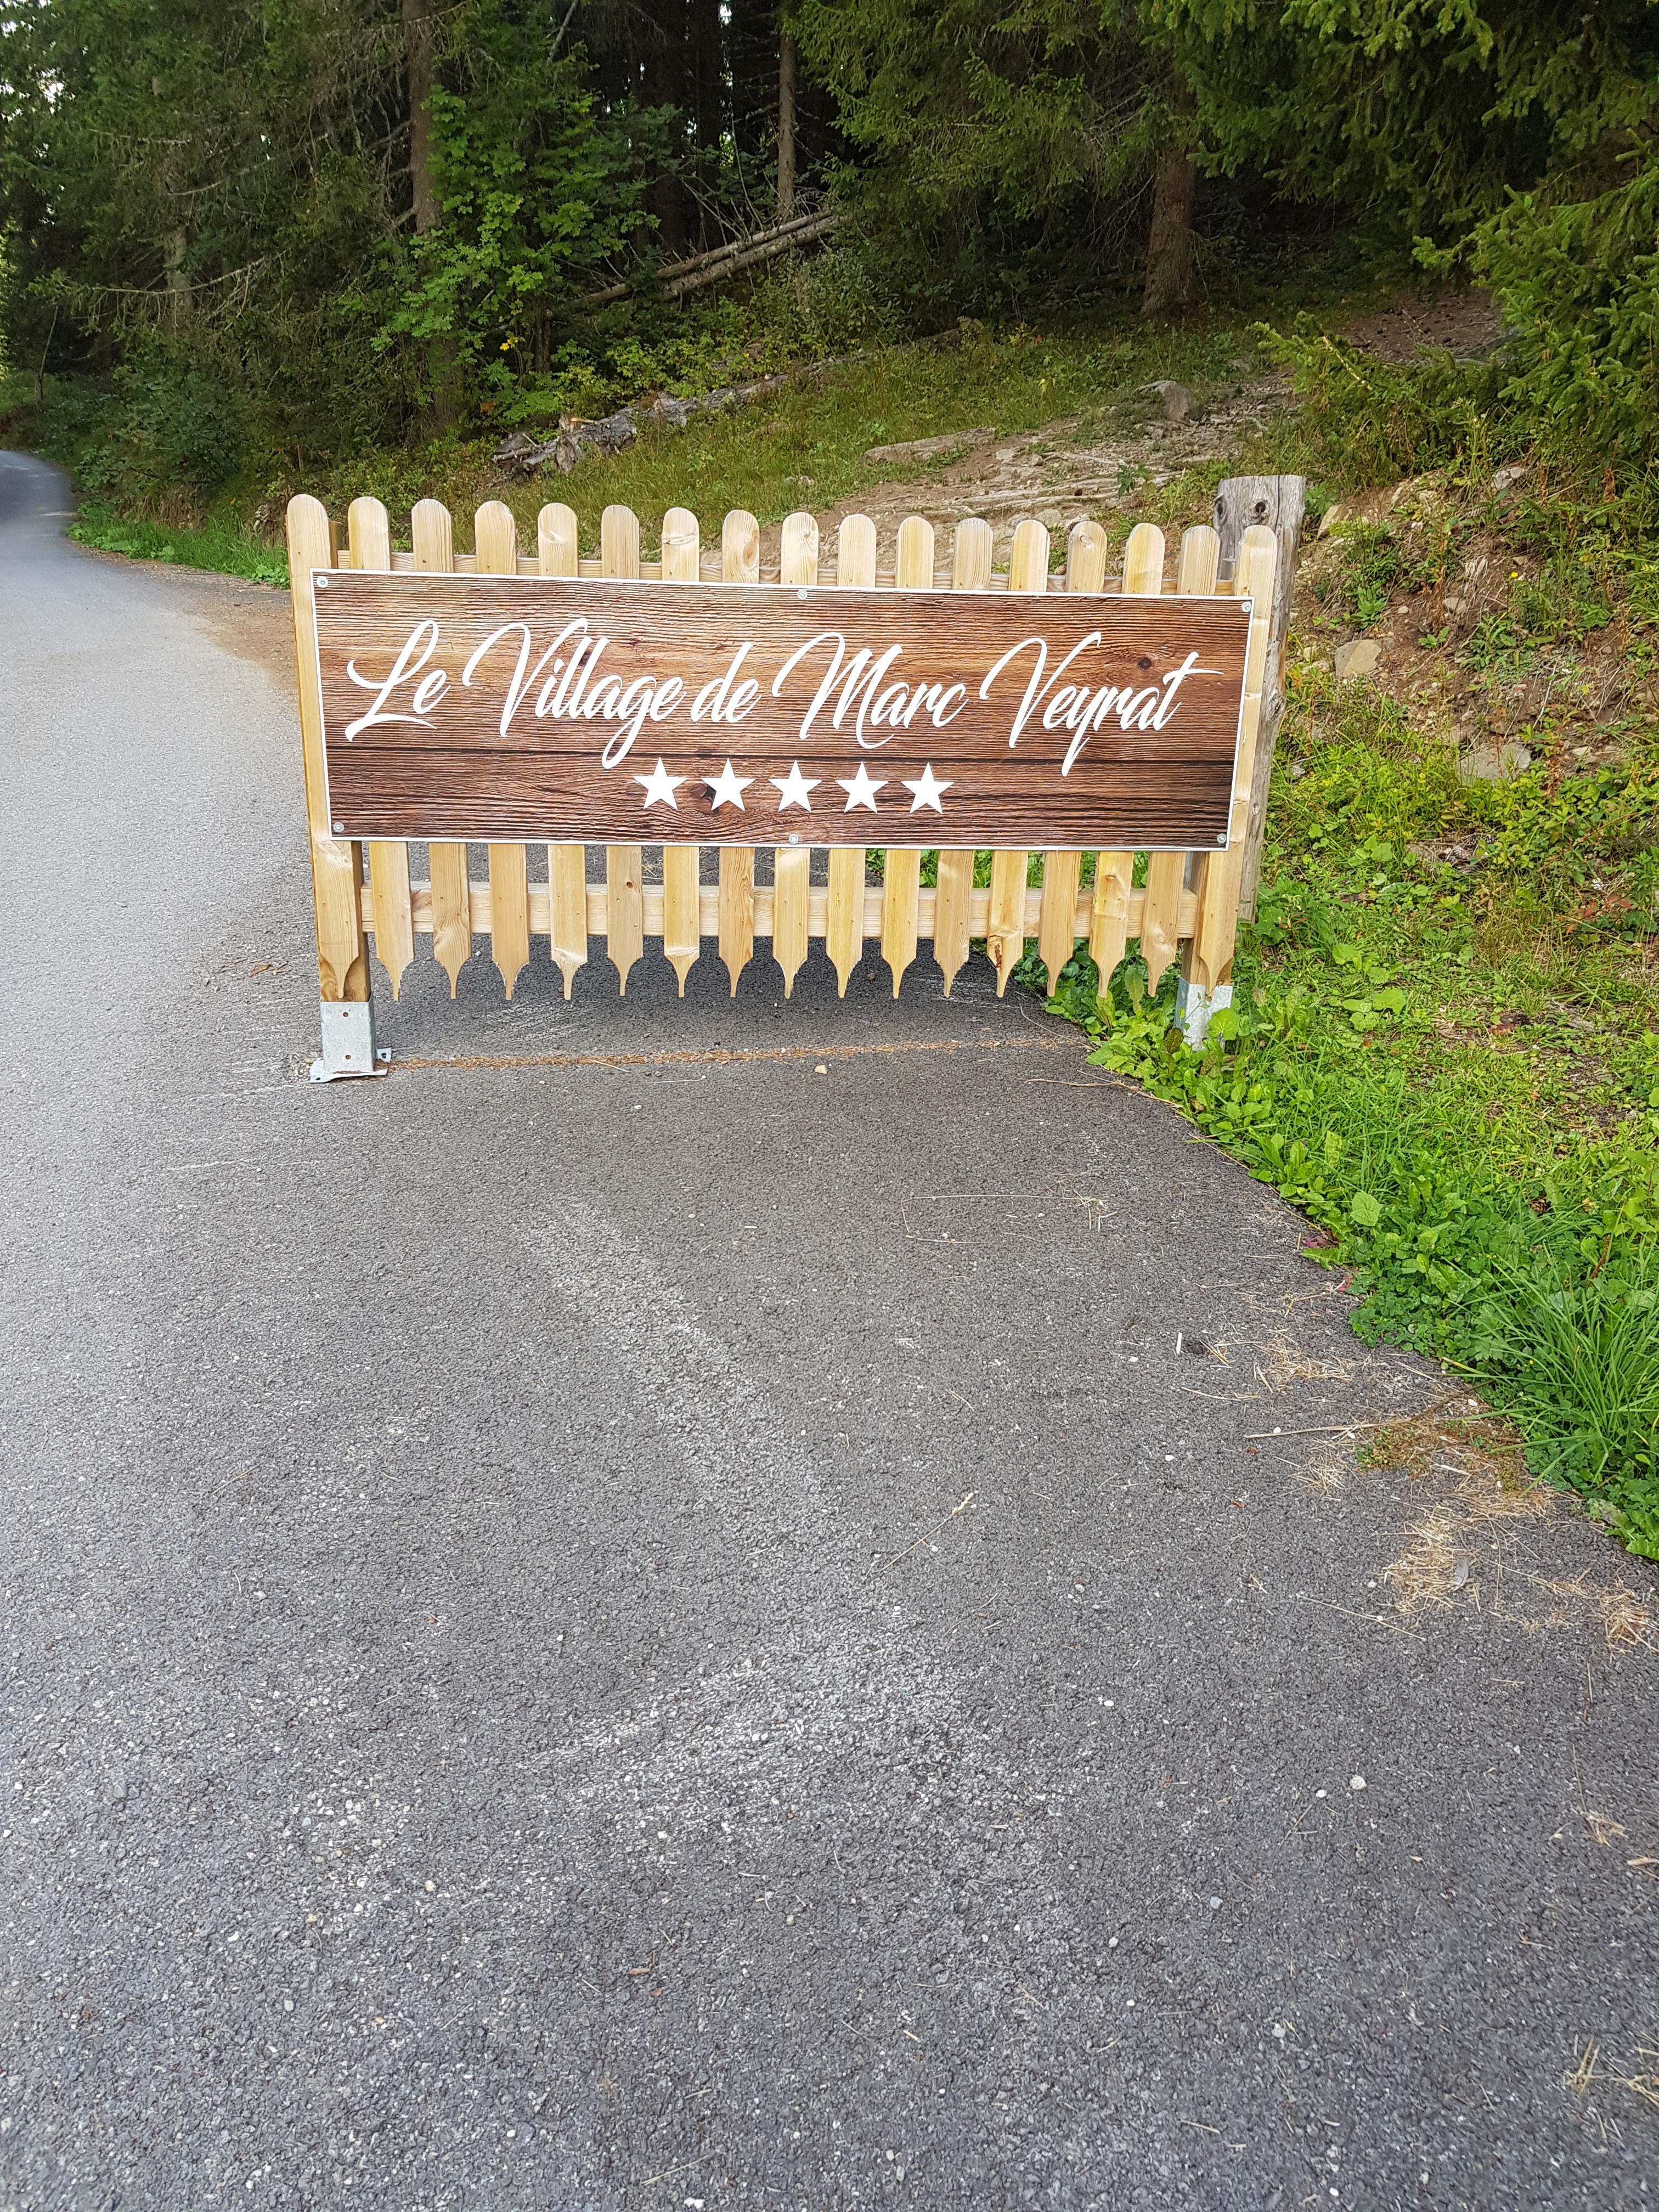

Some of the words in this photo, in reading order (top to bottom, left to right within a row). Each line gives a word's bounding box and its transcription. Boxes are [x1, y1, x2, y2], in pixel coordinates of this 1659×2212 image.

[345, 619, 451, 741] Le
[462, 617, 687, 769] Village
[690, 641, 762, 723] de
[771, 631, 968, 749] Marc
[979, 631, 1224, 777] Veyrat
